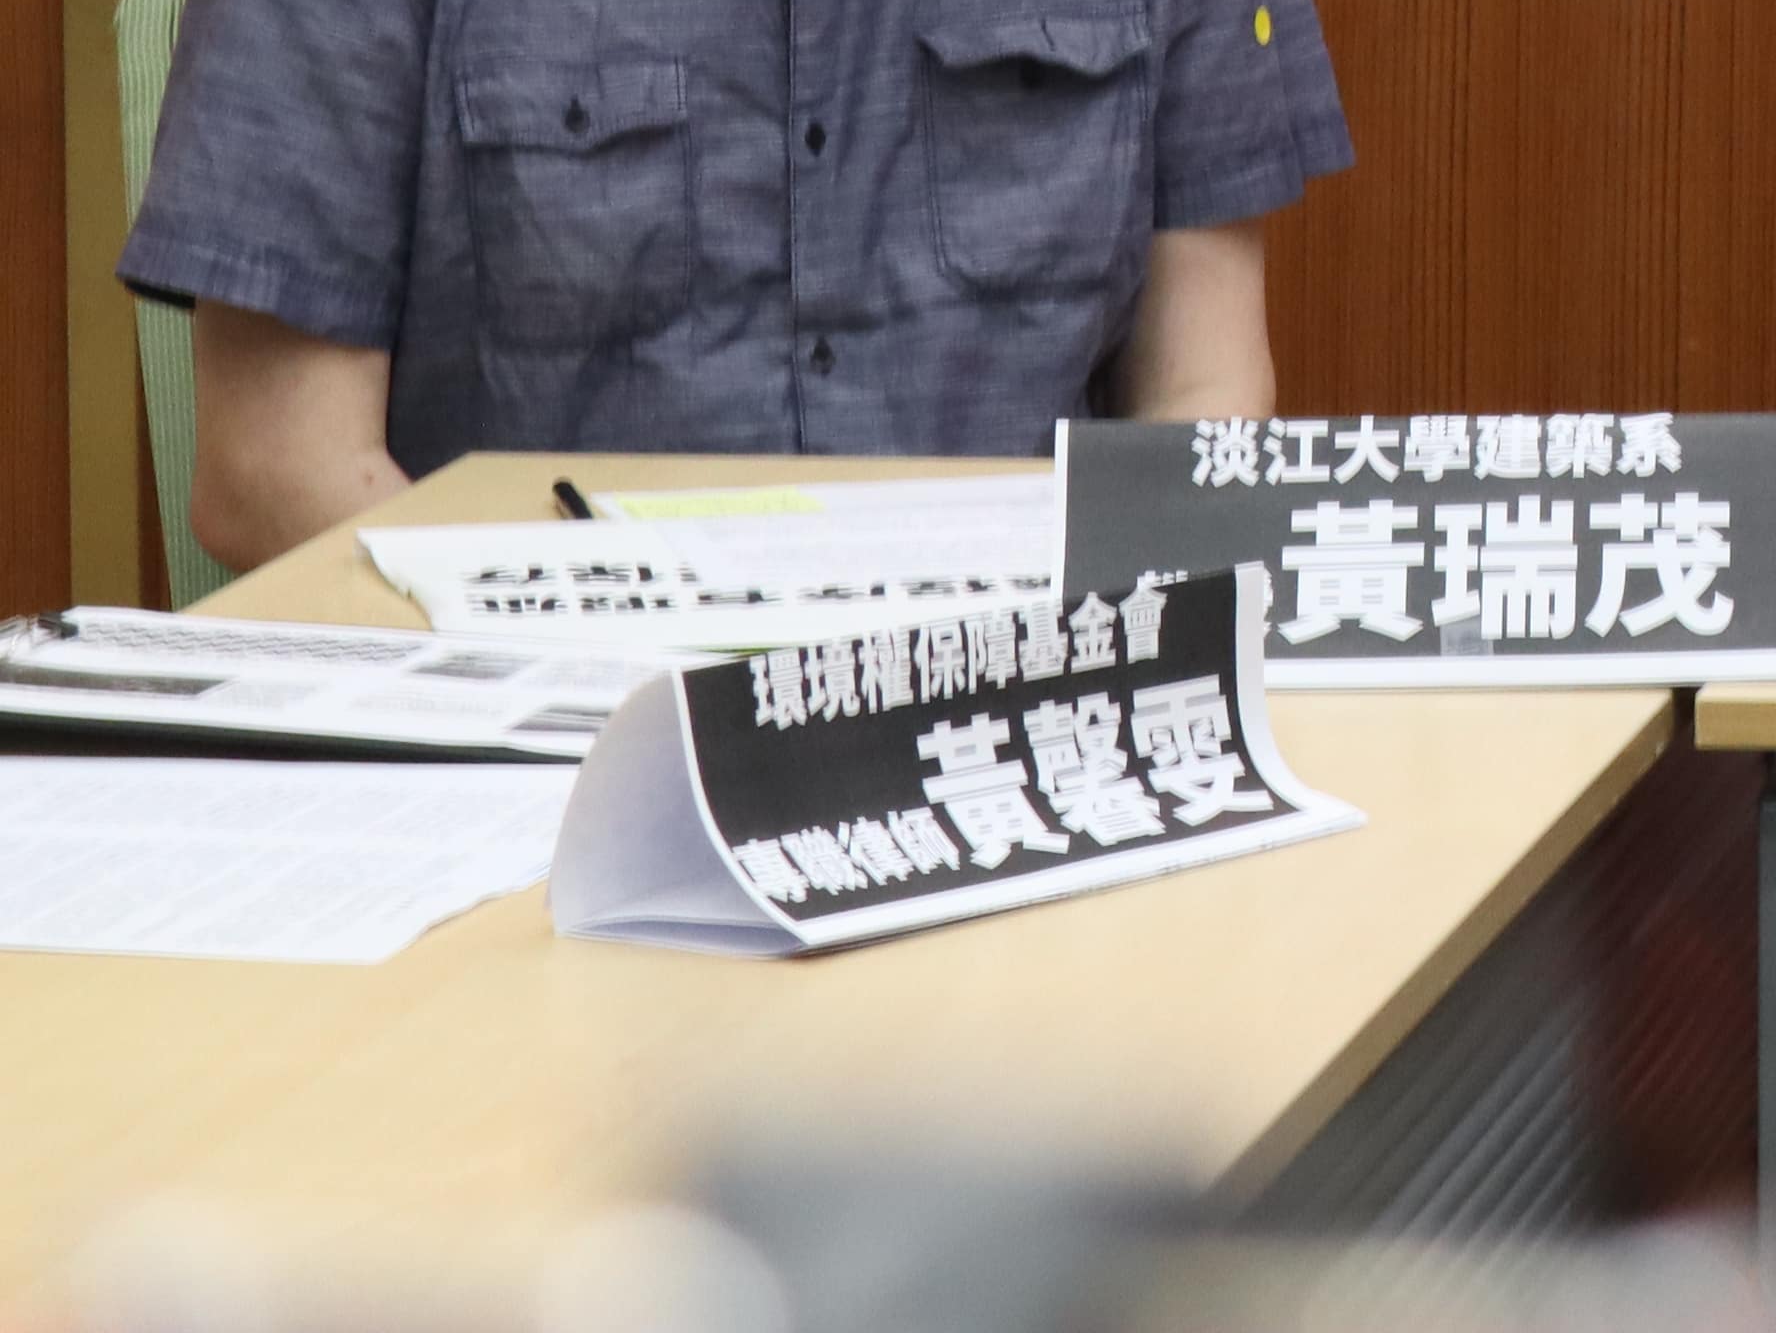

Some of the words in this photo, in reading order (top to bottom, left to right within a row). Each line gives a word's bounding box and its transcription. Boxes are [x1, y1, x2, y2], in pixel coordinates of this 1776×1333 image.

[1191, 412, 1683, 487] 淡江大學建築系
[1278, 491, 1735, 645] 黃瑞茂
[750, 581, 1168, 731] 環境權保障基金會
[916, 674, 1274, 871] 黃馨雯
[733, 807, 961, 904] 專職律師
